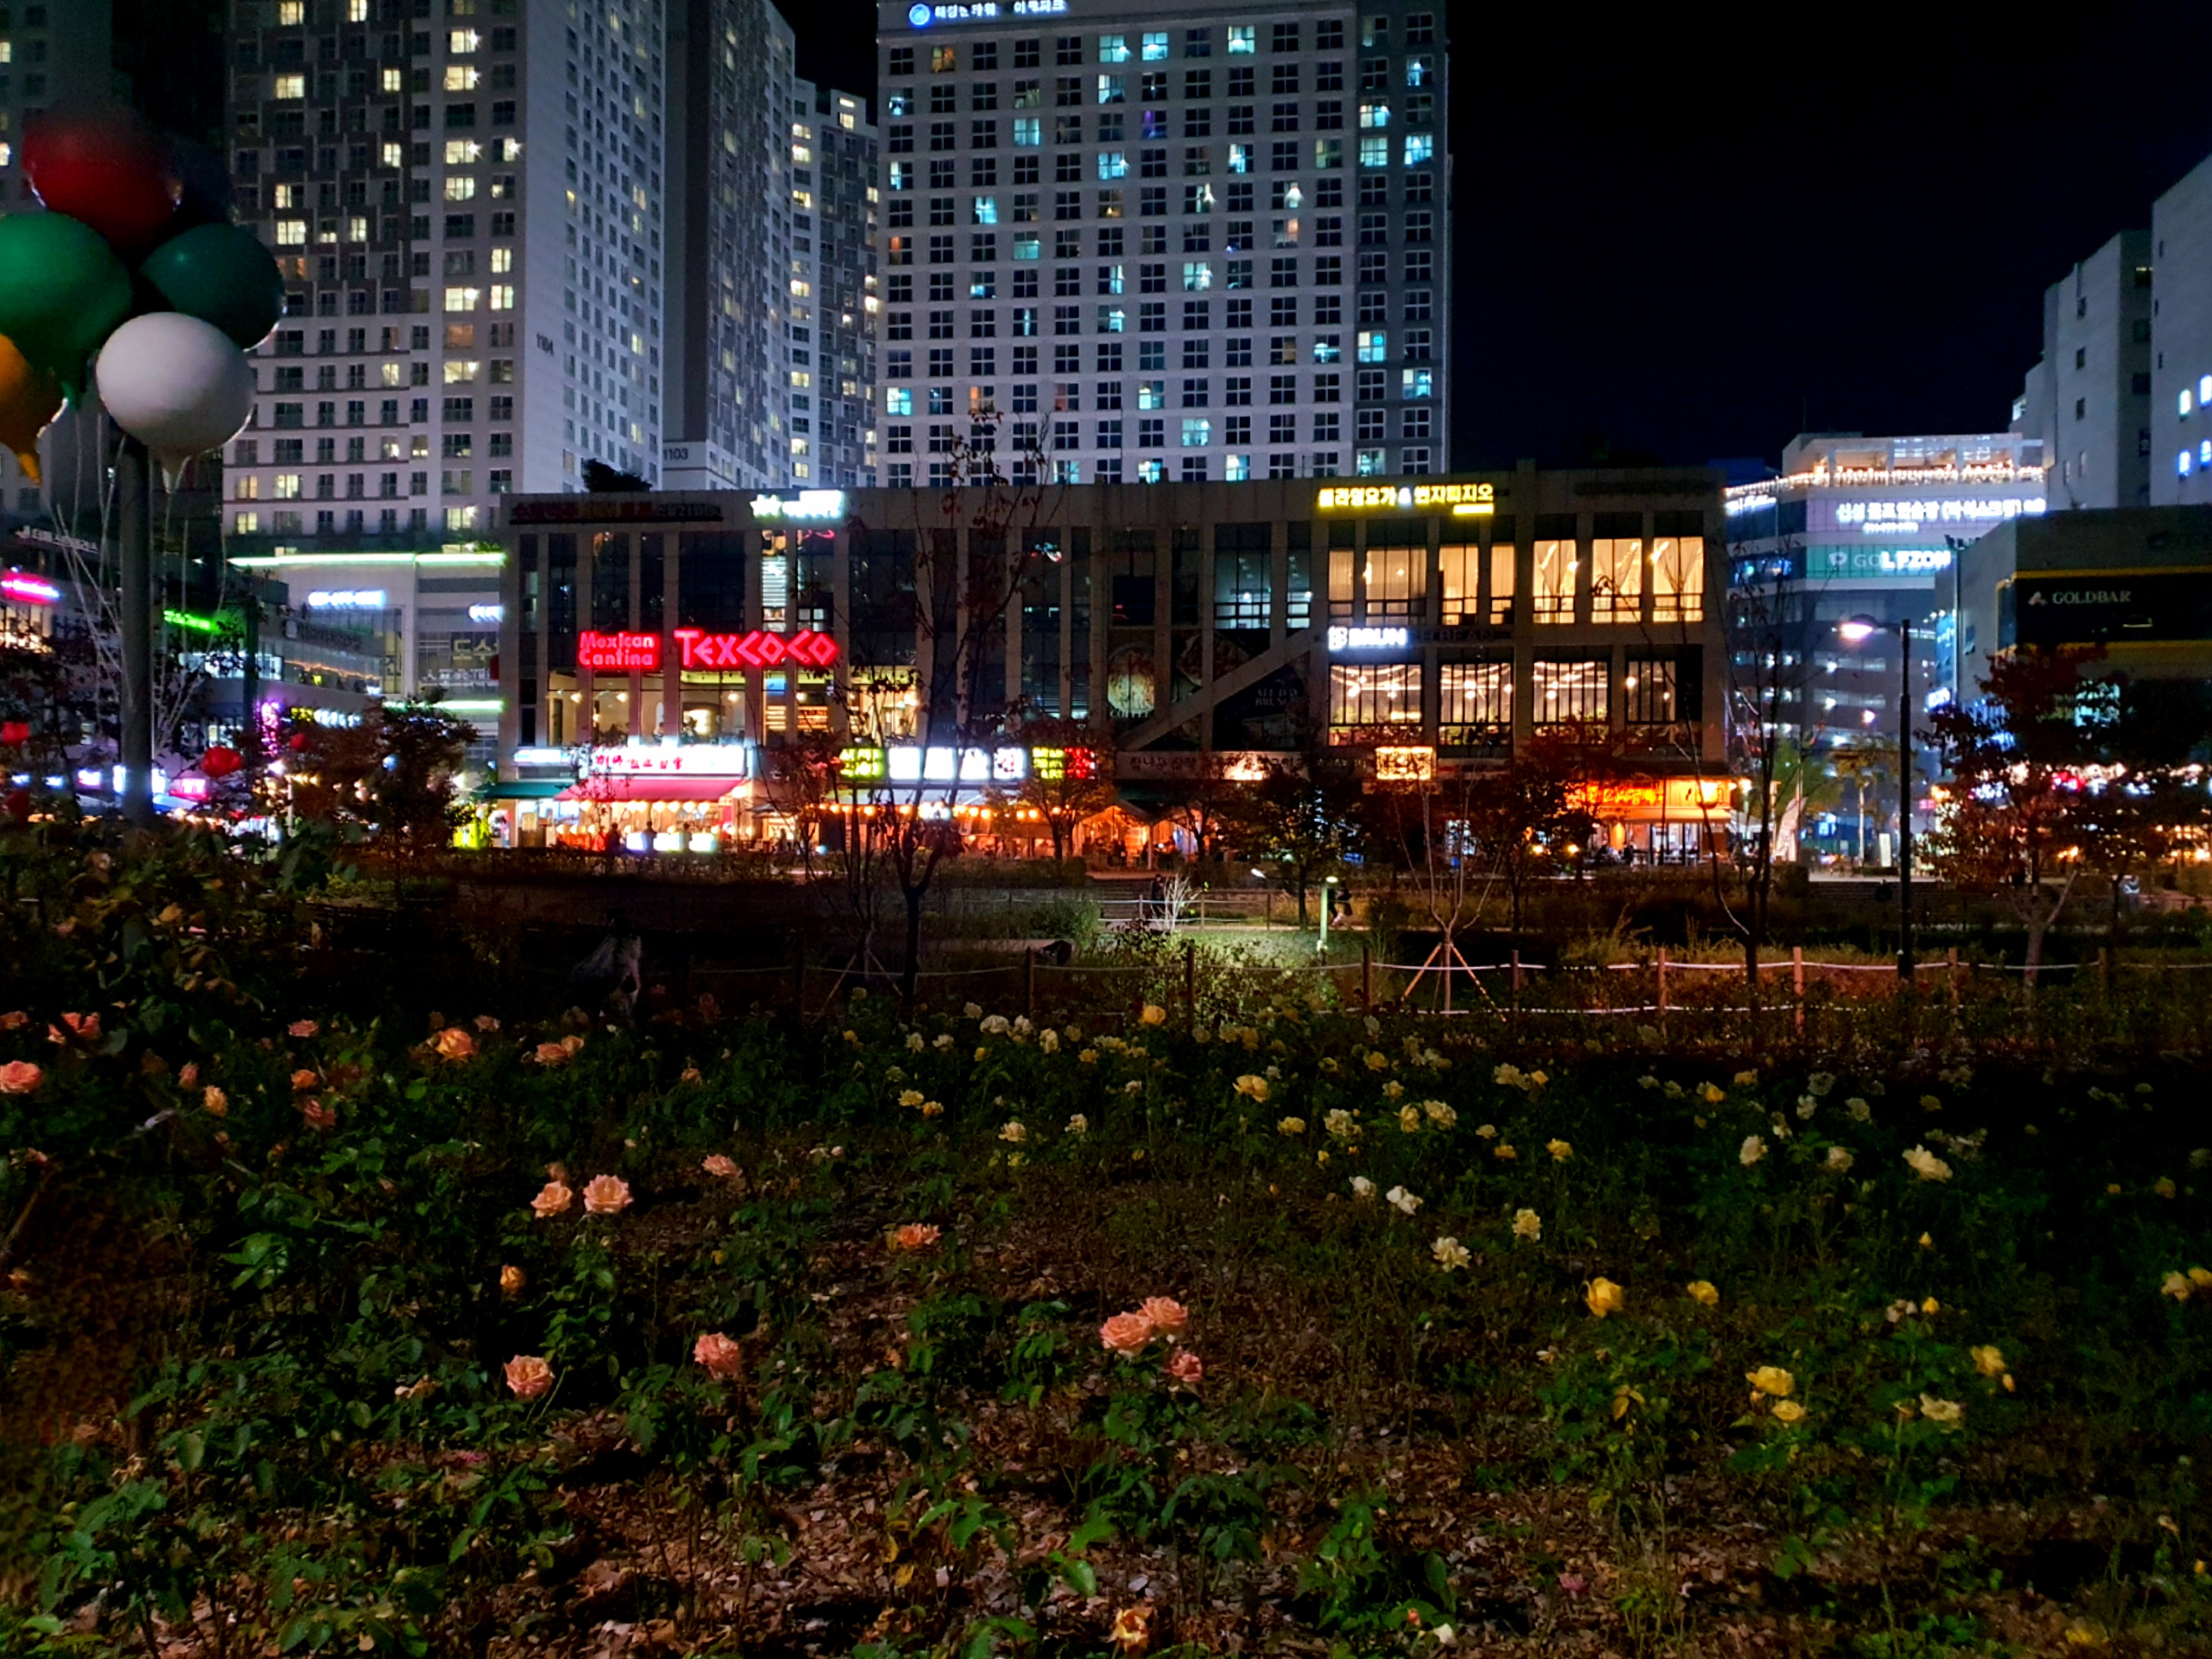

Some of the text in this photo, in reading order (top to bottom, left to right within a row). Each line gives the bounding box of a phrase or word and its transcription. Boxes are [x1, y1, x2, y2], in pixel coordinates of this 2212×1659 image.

[1853, 550, 1952, 571] GOLFZON
[2052, 590, 2132, 605] GOLDBAR
[578, 631, 656, 649] Mexican
[577, 647, 654, 666] Cantina
